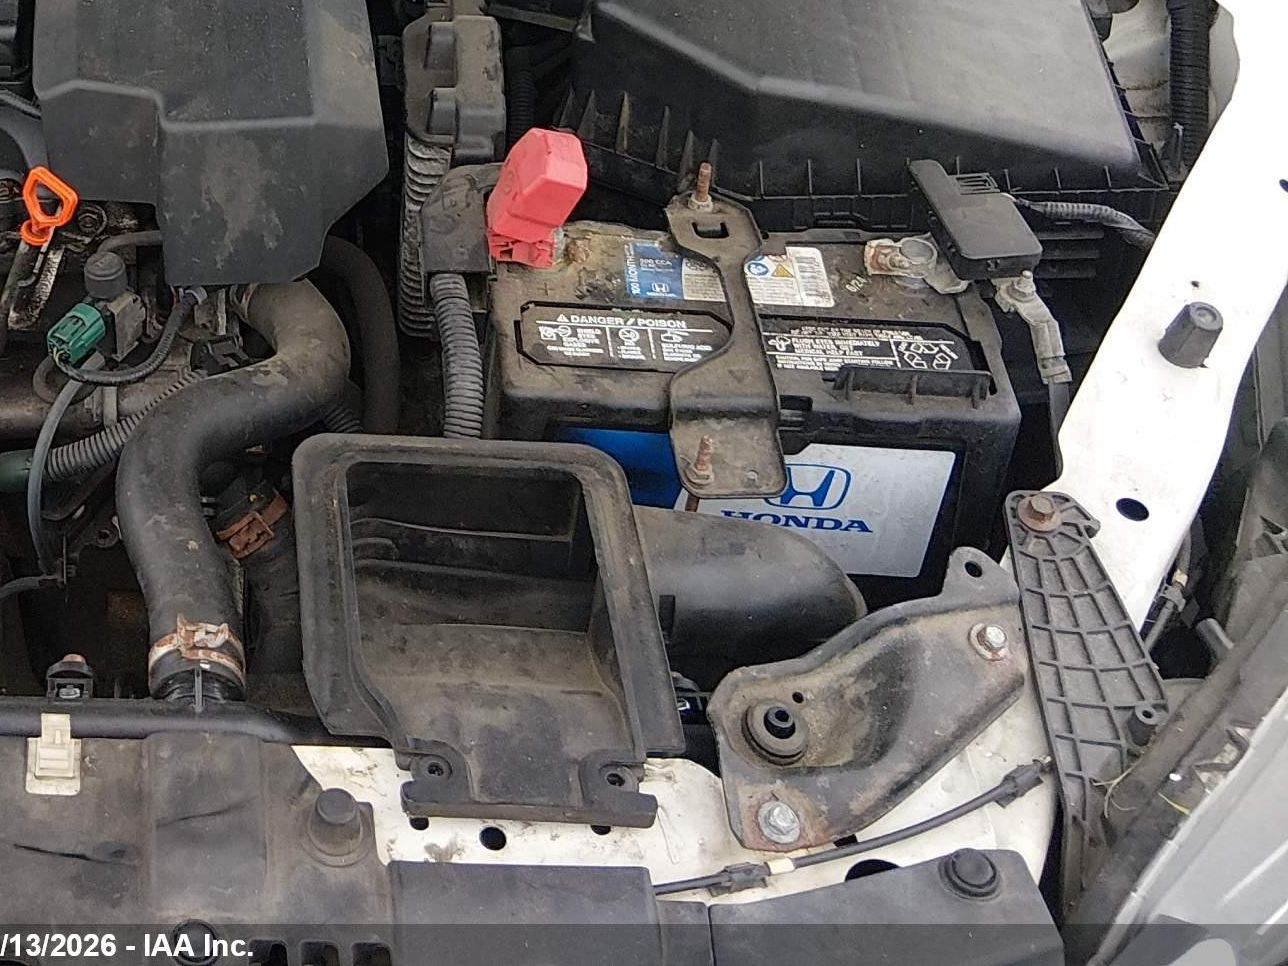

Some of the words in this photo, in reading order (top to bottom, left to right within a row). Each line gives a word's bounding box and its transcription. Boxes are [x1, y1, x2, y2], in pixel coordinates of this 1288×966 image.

[625, 256, 639, 282] MONTH
[571, 315, 624, 326] DANGER
[637, 318, 687, 329] POISON
[721, 510, 874, 533] HONDA
